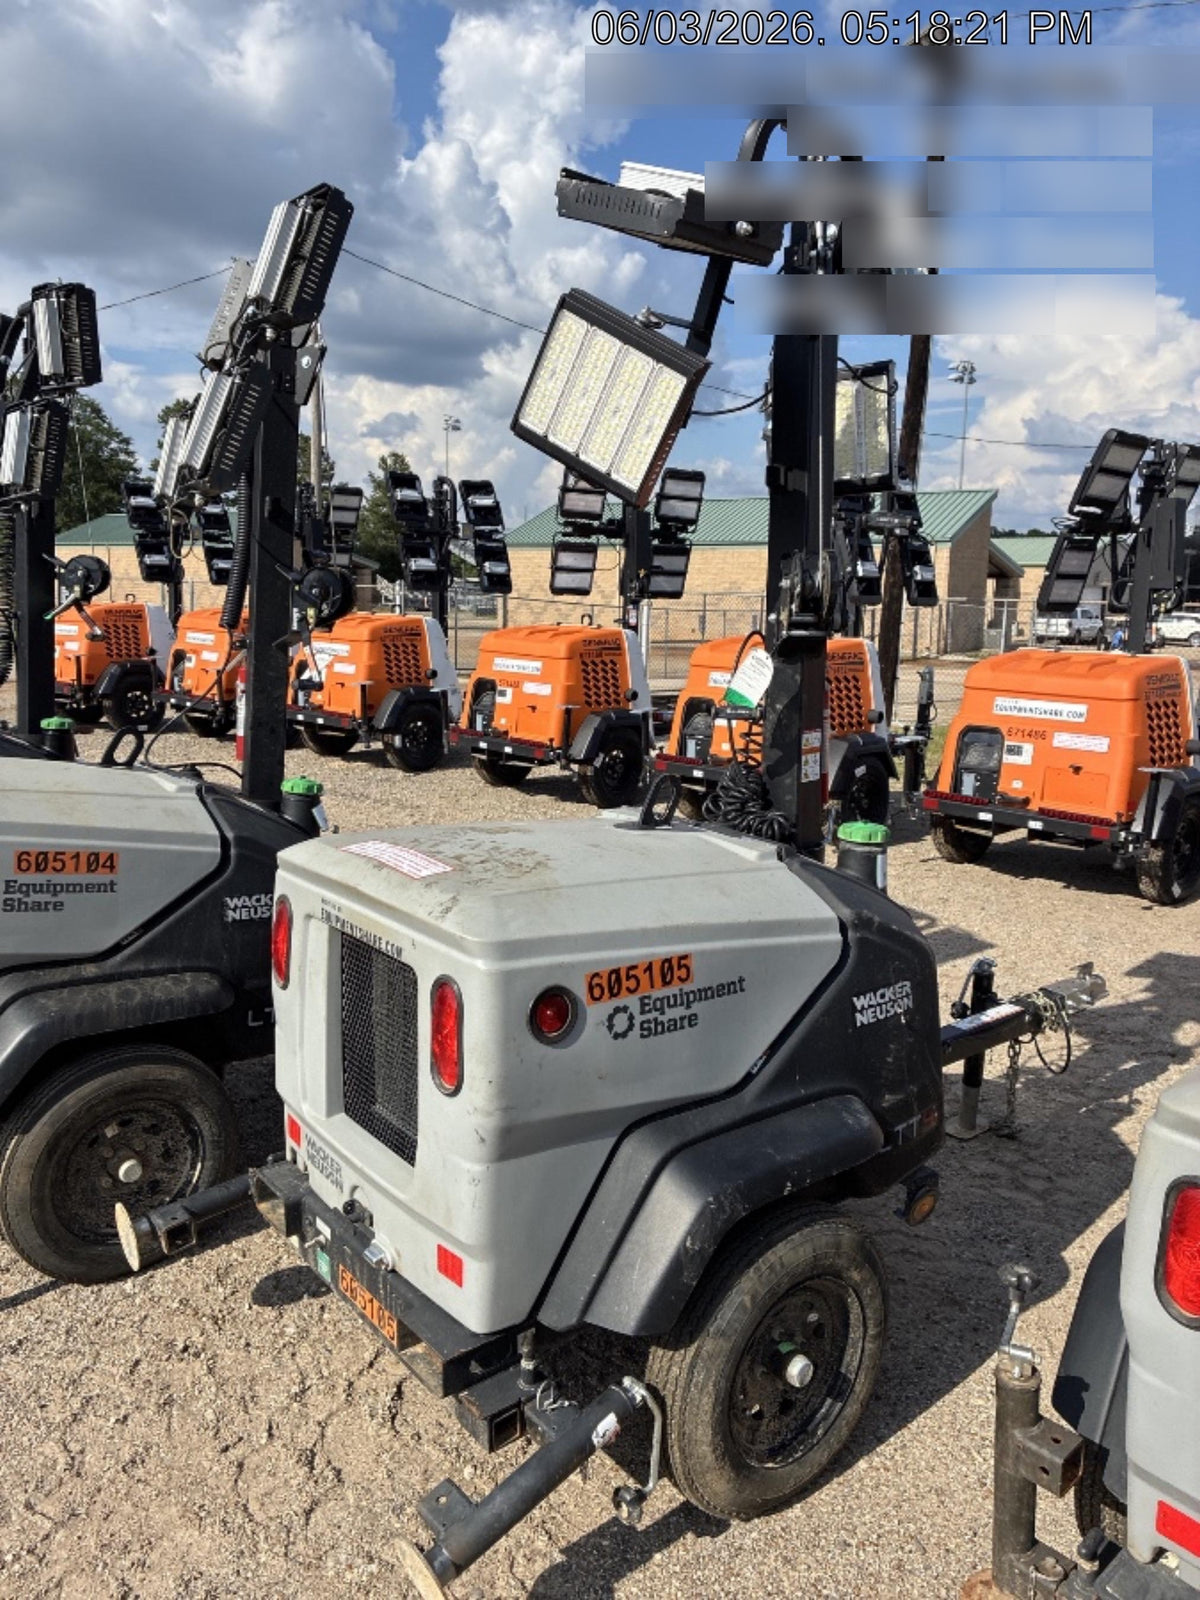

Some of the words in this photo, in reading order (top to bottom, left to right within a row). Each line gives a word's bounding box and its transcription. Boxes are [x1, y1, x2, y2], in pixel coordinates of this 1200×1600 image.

[3, 879, 118, 898] Equipment
[1, 897, 65, 913] Share
[223, 893, 273, 909] WACK
[223, 906, 273, 922] NEUS
[638, 975, 747, 1016] Equipment
[852, 980, 912, 1011] WACKER
[855, 994, 914, 1028] NEUSON
[639, 1012, 699, 1039] Share
